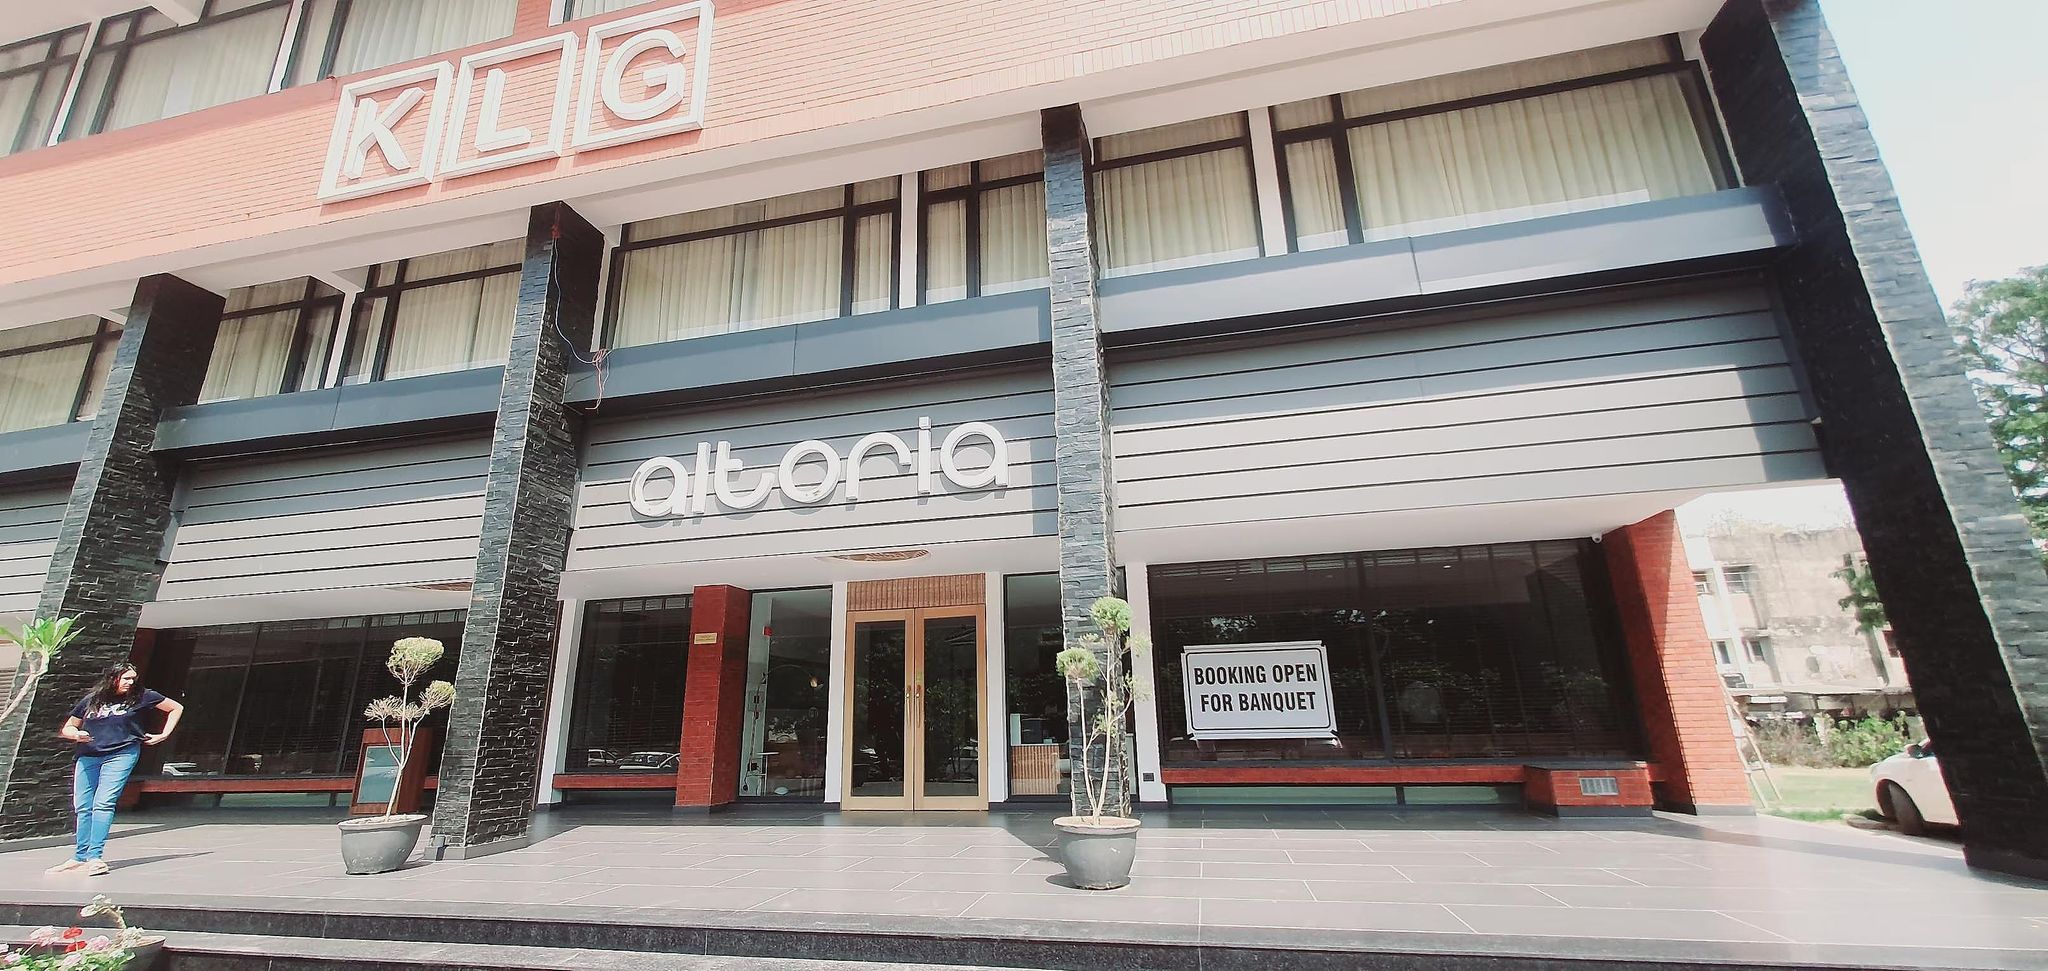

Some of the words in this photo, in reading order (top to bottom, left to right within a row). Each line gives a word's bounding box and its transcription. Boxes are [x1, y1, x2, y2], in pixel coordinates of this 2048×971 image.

[343, 29, 687, 180] KLG
[629, 416, 1009, 517] altoria
[1194, 664, 1267, 685] BOOKING
[1272, 663, 1318, 683] OPEN
[1200, 693, 1234, 712] FOR
[1238, 691, 1316, 712] BANQUET
